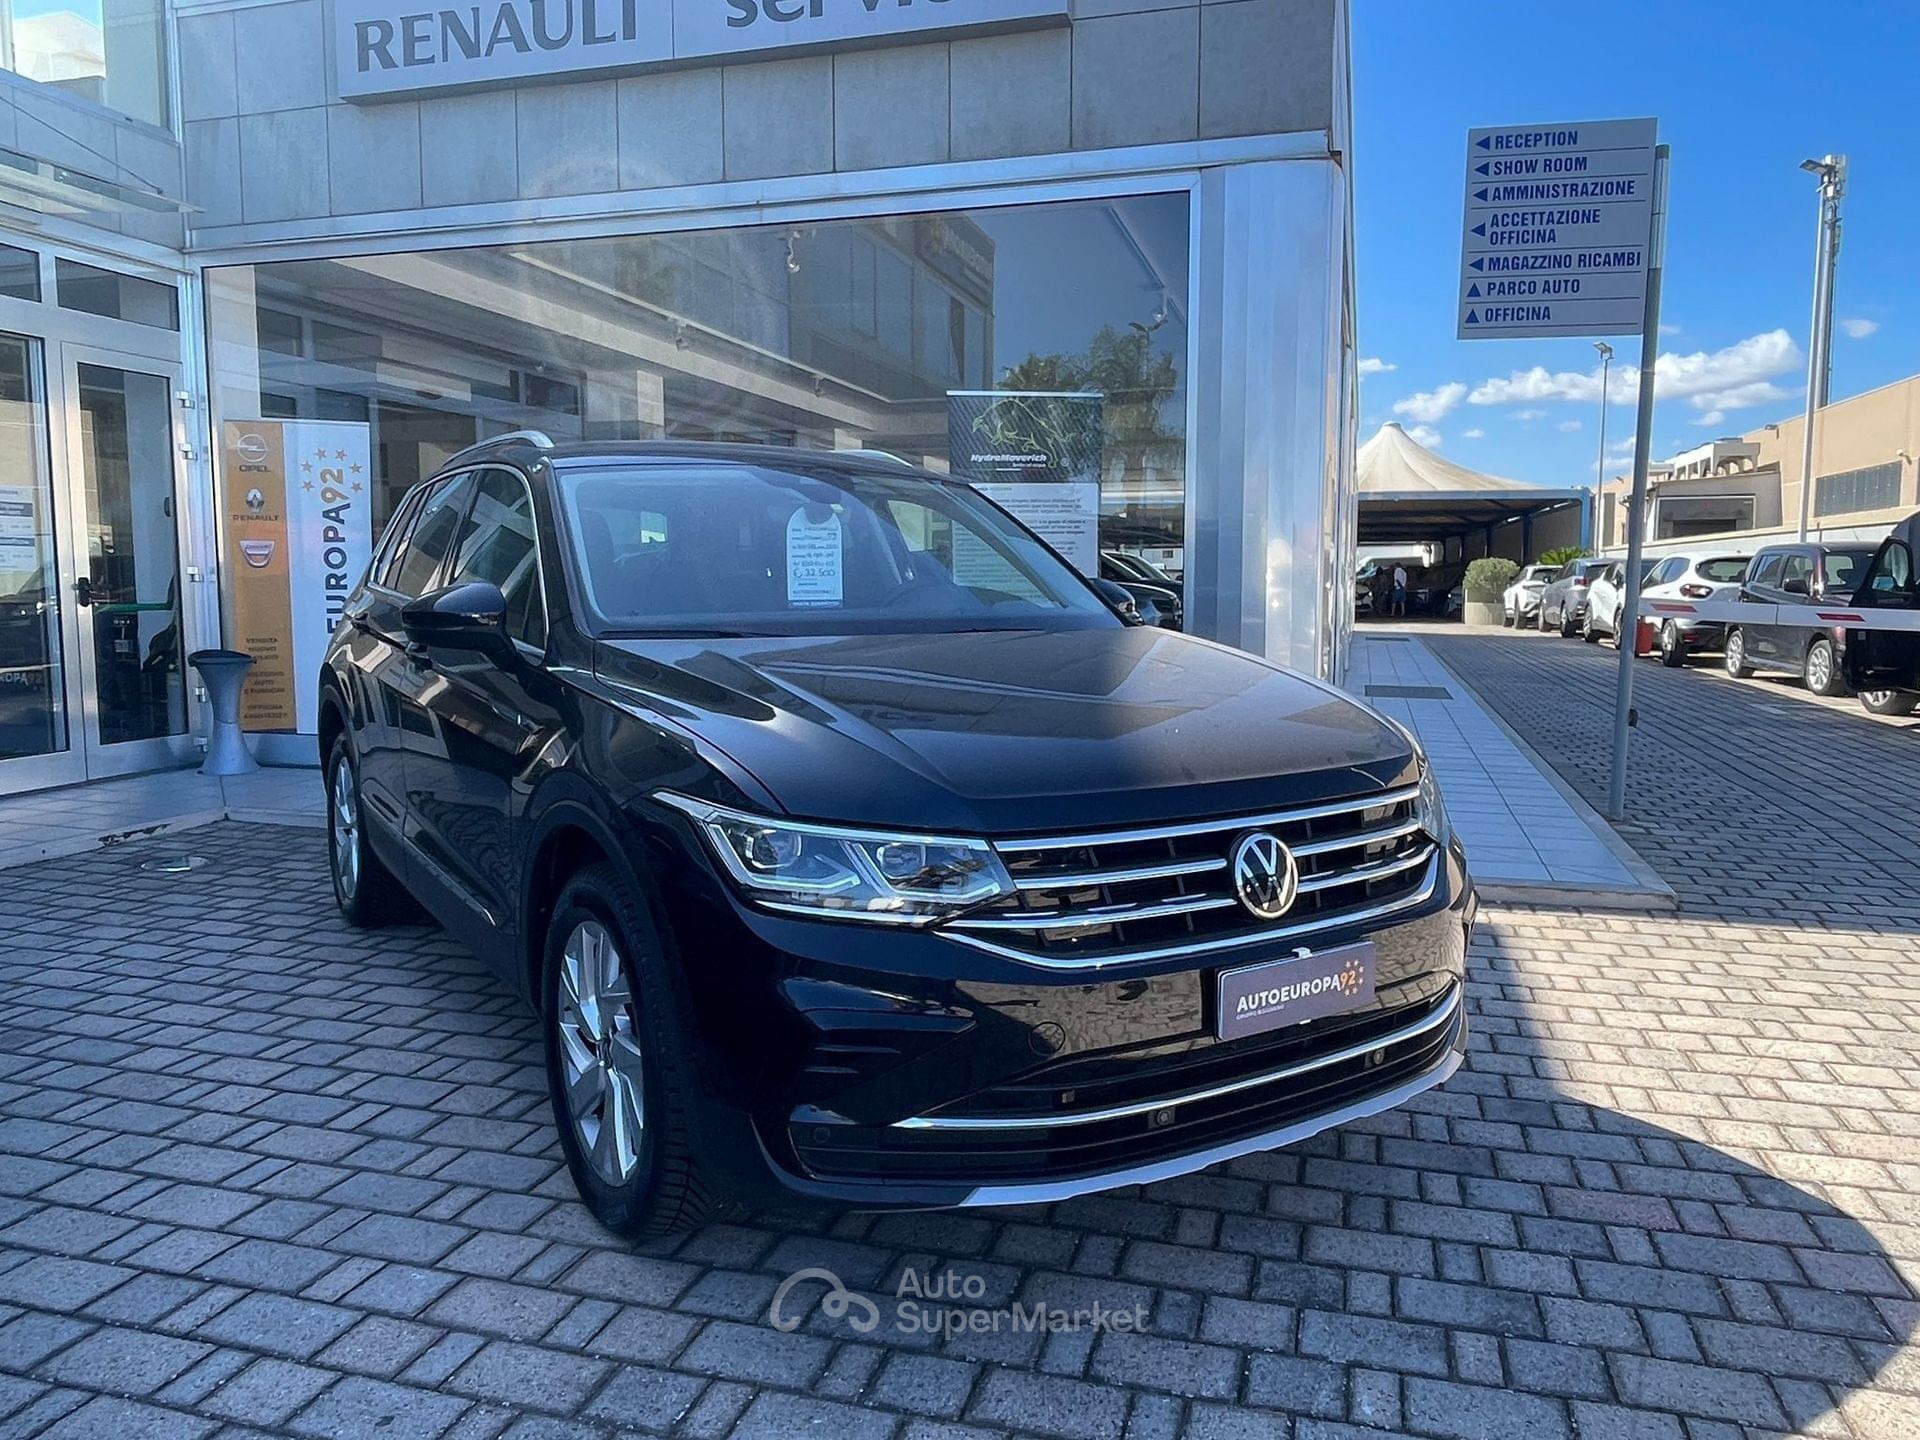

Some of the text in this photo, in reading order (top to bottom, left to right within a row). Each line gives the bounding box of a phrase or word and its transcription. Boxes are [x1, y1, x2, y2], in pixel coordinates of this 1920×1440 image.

[1495, 131, 1578, 149] RECEPTION
[1493, 156, 1588, 176] SHOW ROOM
[1492, 180, 1635, 201] AMMINISTRAZIONE
[1490, 209, 1601, 228] ACCETTAZIONE
[1490, 229, 1556, 245] OFFICINA
[1488, 251, 1641, 271] MAGAZZINO RICAMBI
[1487, 279, 1581, 296] PARCO AUTO
[1484, 306, 1551, 322] OFFICINA
[1237, 970, 1356, 1013] AUTOEUROPA92
